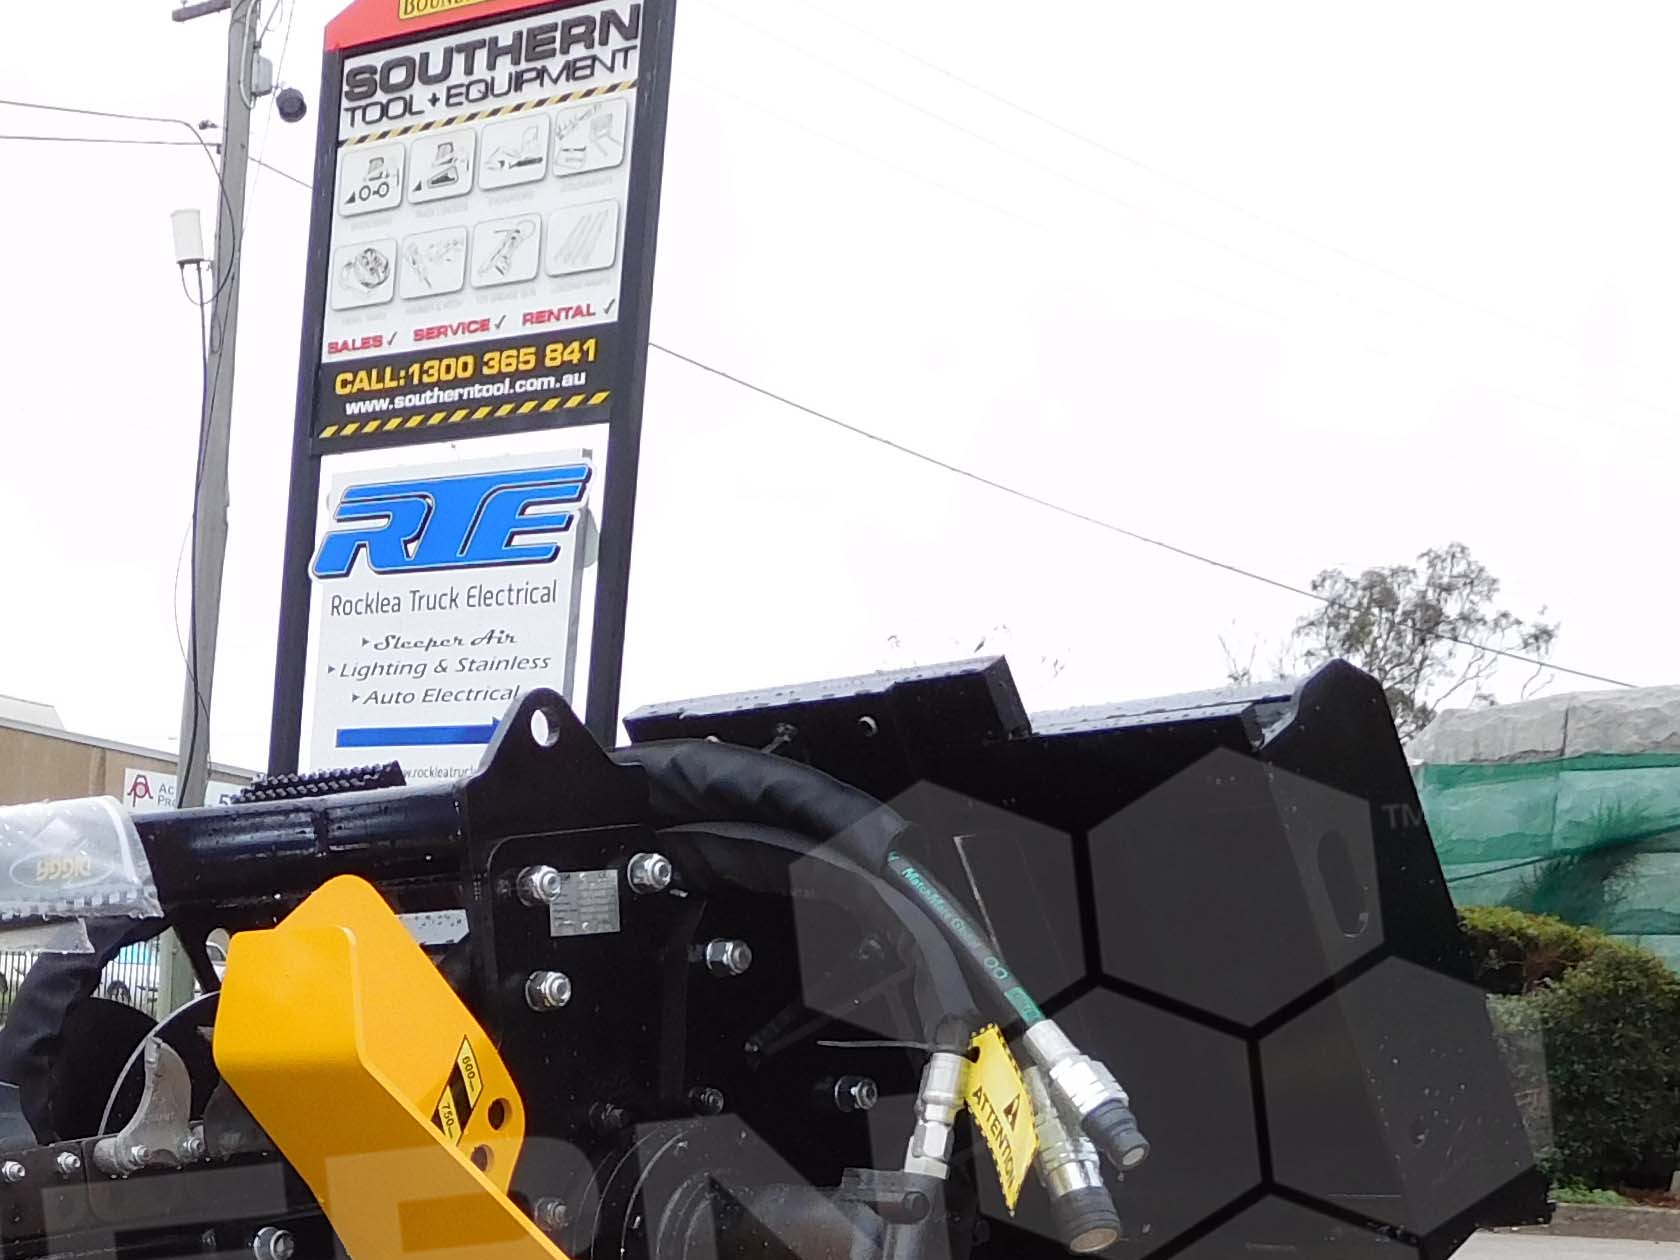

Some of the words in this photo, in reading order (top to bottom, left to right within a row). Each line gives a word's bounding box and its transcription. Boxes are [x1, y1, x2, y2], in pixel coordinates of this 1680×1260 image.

[343, 4, 641, 101] SOUTHERN
[328, 335, 383, 354] SALES
[413, 318, 491, 342] SERVICE
[522, 303, 597, 326] RENTAL
[482, 346, 537, 375] 365
[544, 338, 598, 368] 841
[345, 371, 587, 416] www.southerntool.com.au
[311, 462, 593, 580] RTE
[330, 591, 401, 617] Rocklea
[409, 586, 459, 612] Truck
[466, 579, 558, 608] Electrical
[373, 632, 465, 653] Sleeper
[470, 628, 518, 647] Air
[339, 661, 428, 681] Lighting
[433, 658, 449, 674] &
[456, 654, 552, 673] Stainless
[362, 688, 416, 705] Auto
[421, 684, 521, 703] Electrical
[972, 1085, 1016, 1189] ATTENTION
